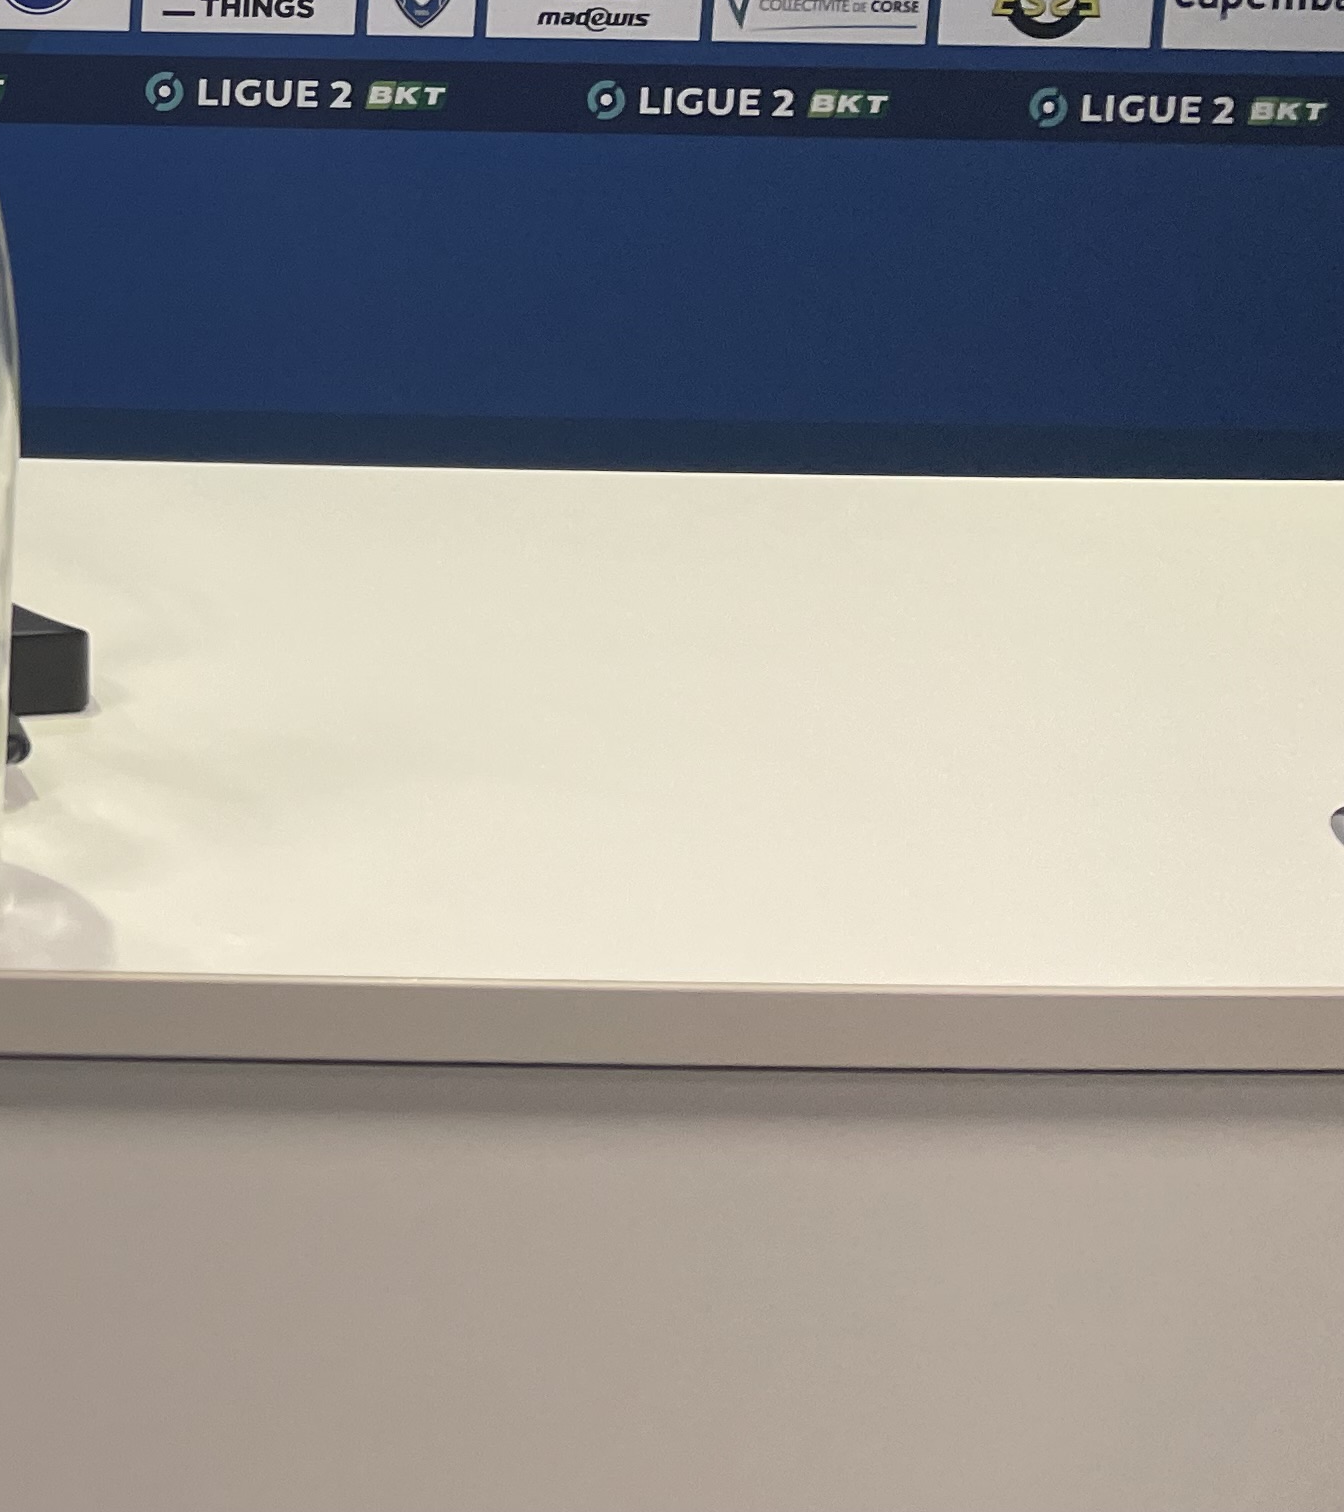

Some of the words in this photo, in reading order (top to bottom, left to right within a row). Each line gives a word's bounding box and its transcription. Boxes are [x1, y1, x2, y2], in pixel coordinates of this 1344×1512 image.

[639, 86, 760, 117] LIGUE
[771, 89, 795, 118] 2
[812, 94, 888, 114] BKT
[1081, 94, 1201, 124] LIGUE
[1212, 96, 1235, 125] 2
[1250, 101, 1327, 121] BKT
